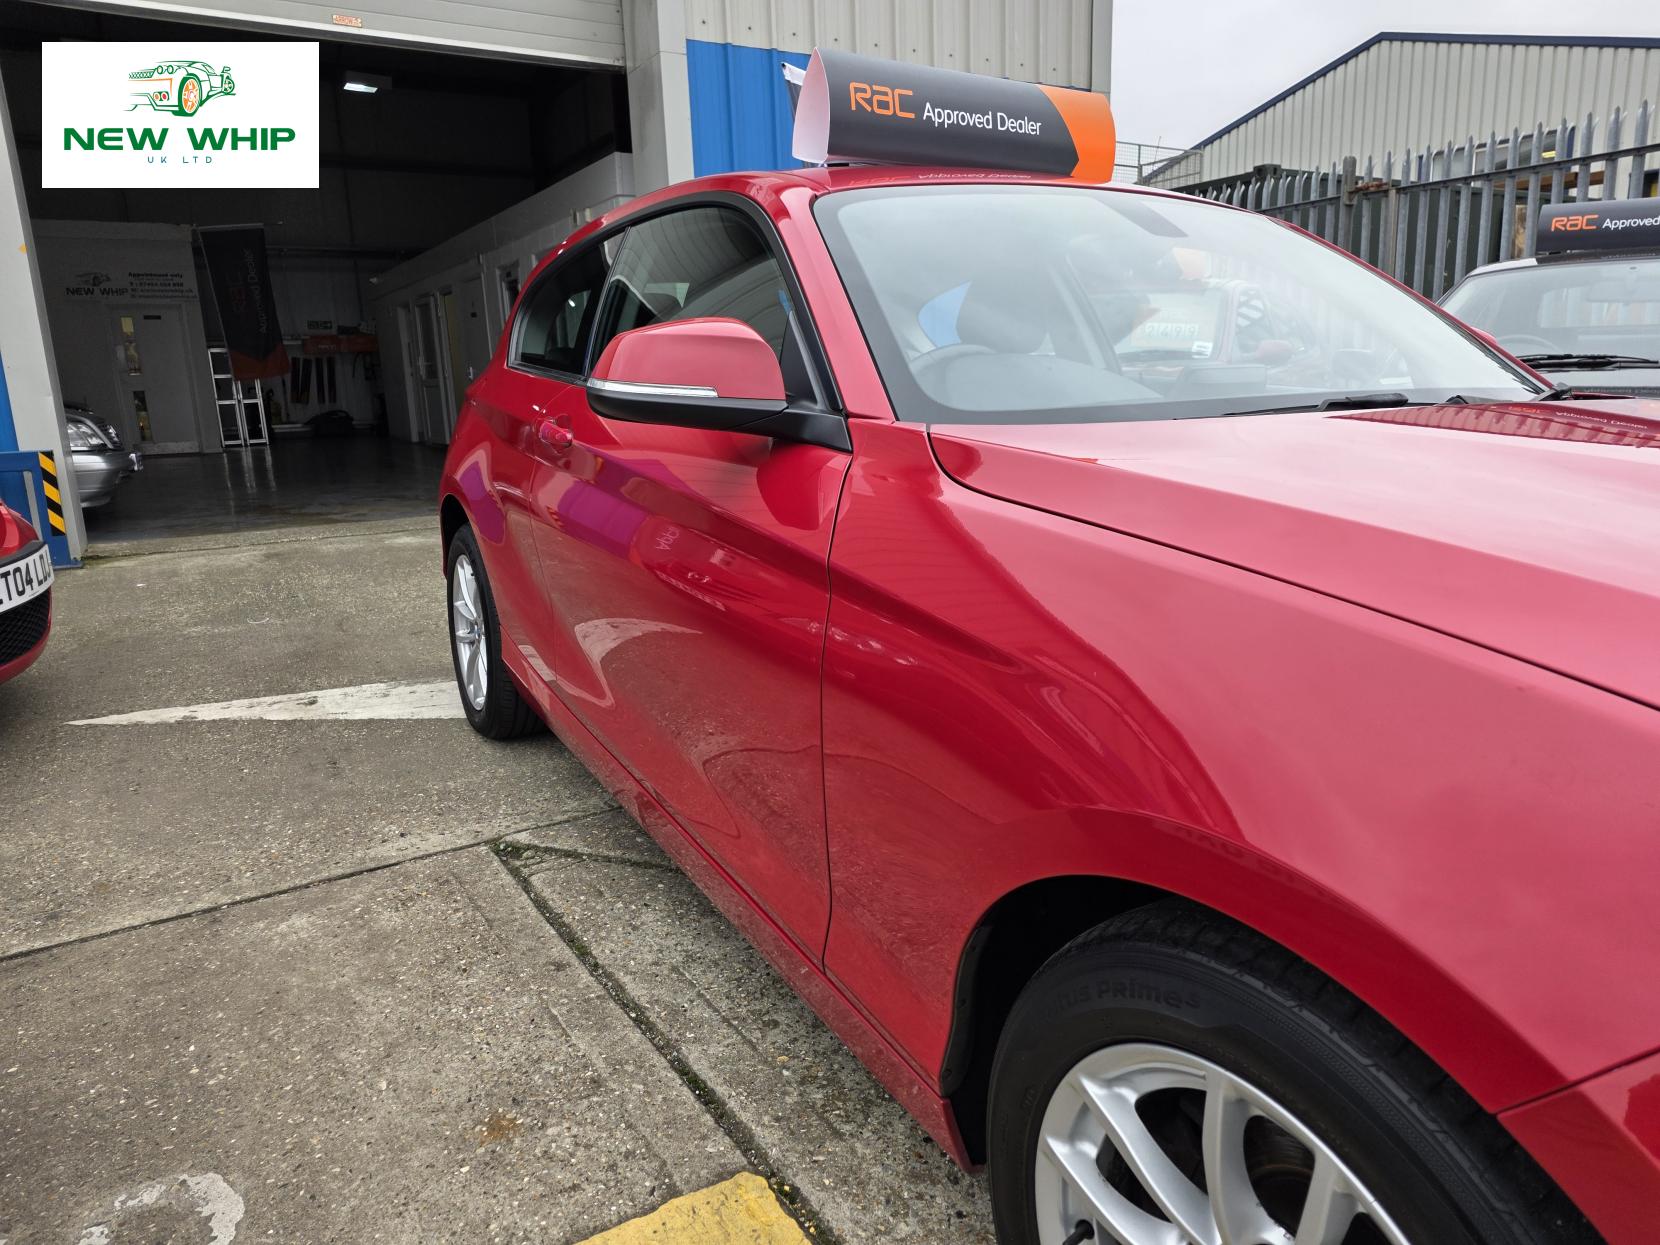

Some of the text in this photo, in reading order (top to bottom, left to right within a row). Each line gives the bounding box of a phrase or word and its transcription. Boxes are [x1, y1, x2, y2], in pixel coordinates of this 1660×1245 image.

[923, 102, 992, 129] Approved
[997, 112, 1042, 136] Dealer
[1602, 214, 1660, 231] Approved
[66, 287, 95, 296] NEW
[100, 287, 129, 297] WHIP
[0, 561, 34, 605] T04
